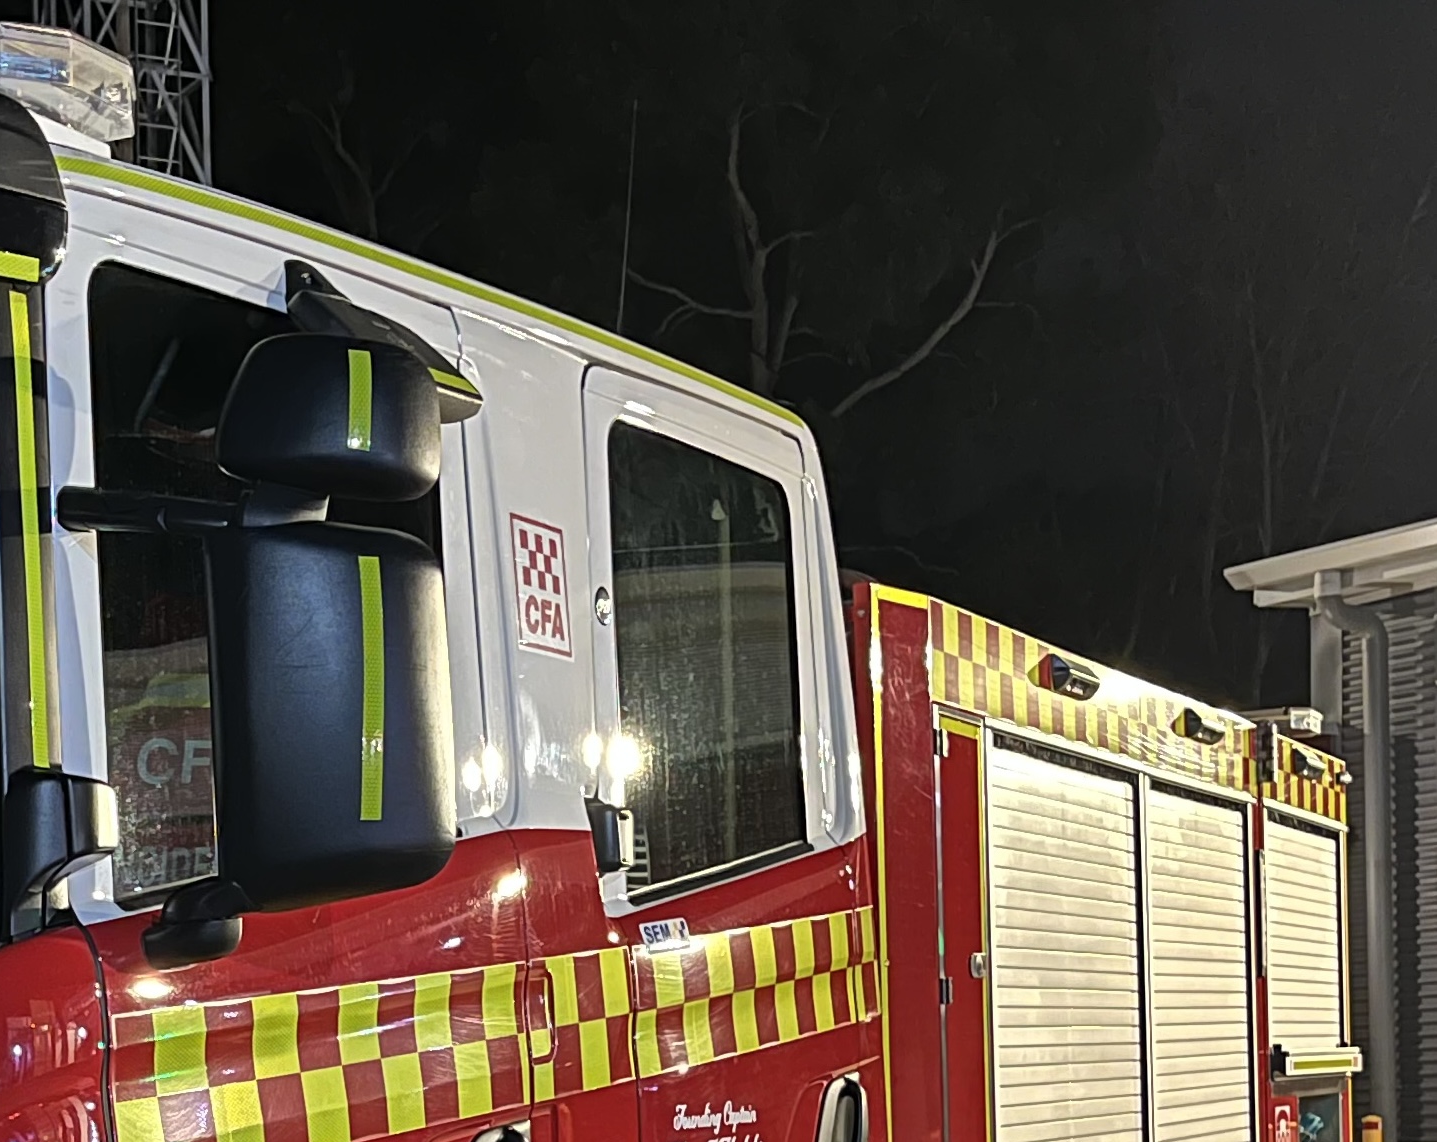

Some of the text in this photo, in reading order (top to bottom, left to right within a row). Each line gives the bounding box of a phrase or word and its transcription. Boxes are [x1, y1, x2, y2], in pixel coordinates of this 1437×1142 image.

[525, 595, 565, 642] CFA
[137, 738, 212, 786] CF
[673, 1100, 757, 1135] Founding Captain
